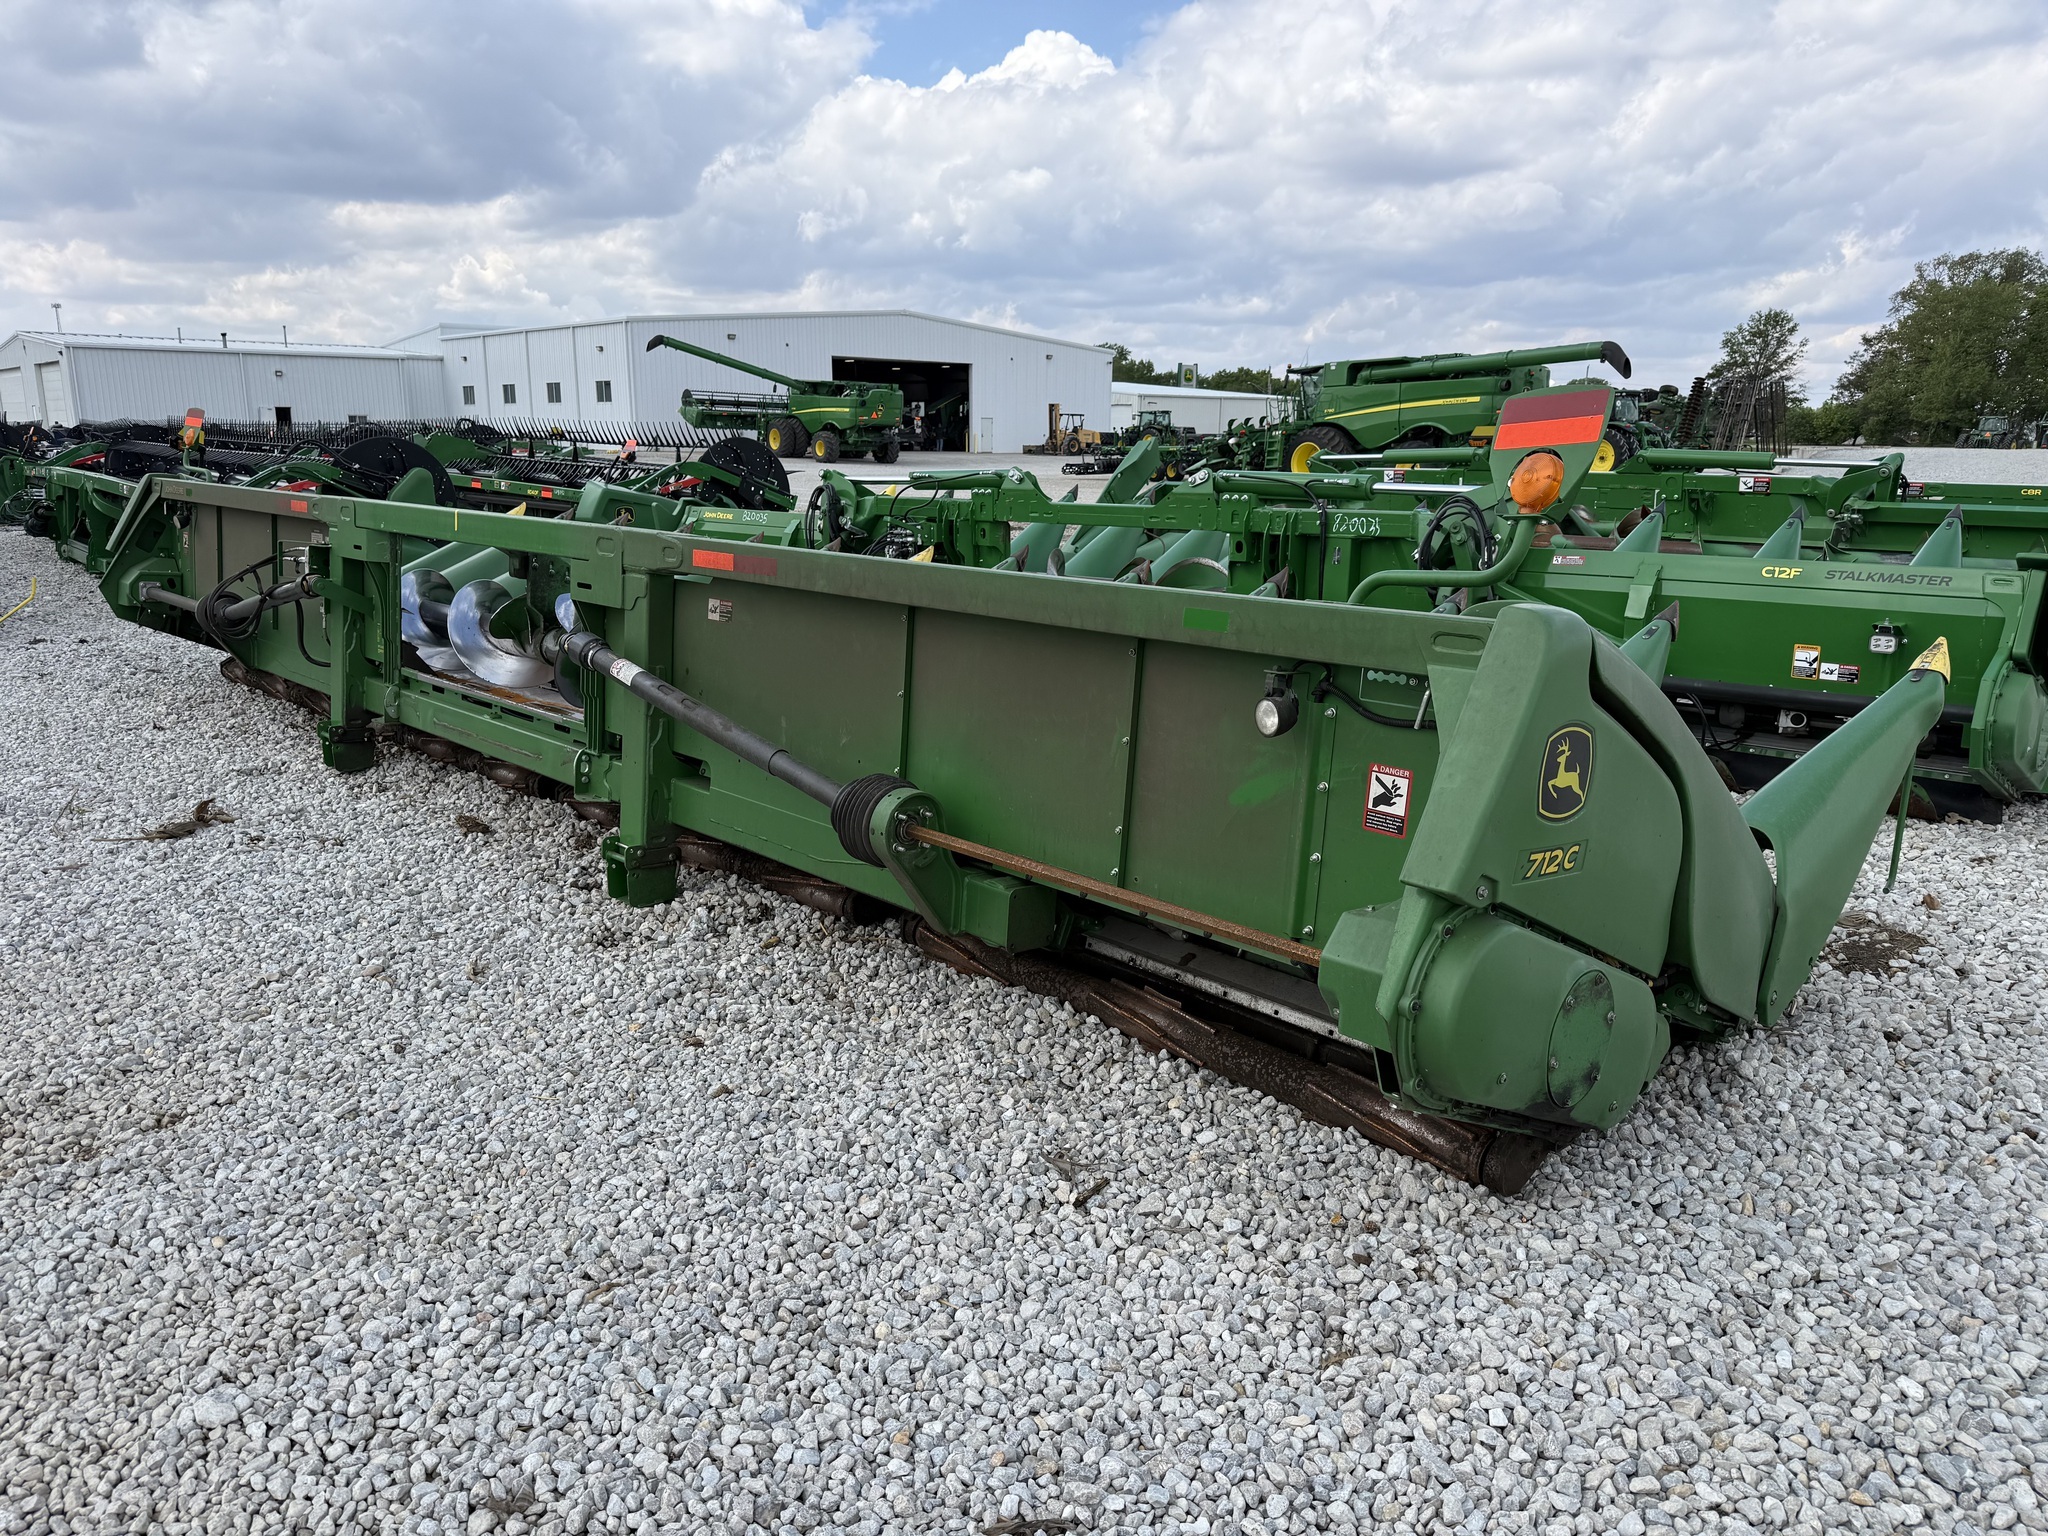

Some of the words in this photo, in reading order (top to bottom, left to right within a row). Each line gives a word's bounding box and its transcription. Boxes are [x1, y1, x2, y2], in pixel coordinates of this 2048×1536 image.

[717, 512, 733, 520] DEERE
[742, 510, 768, 524] 820035
[1761, 566, 1803, 579] C12F
[1824, 569, 1953, 587] STALKMASTER
[1380, 765, 1410, 778] DANGER
[1524, 844, 1581, 878] 712C
